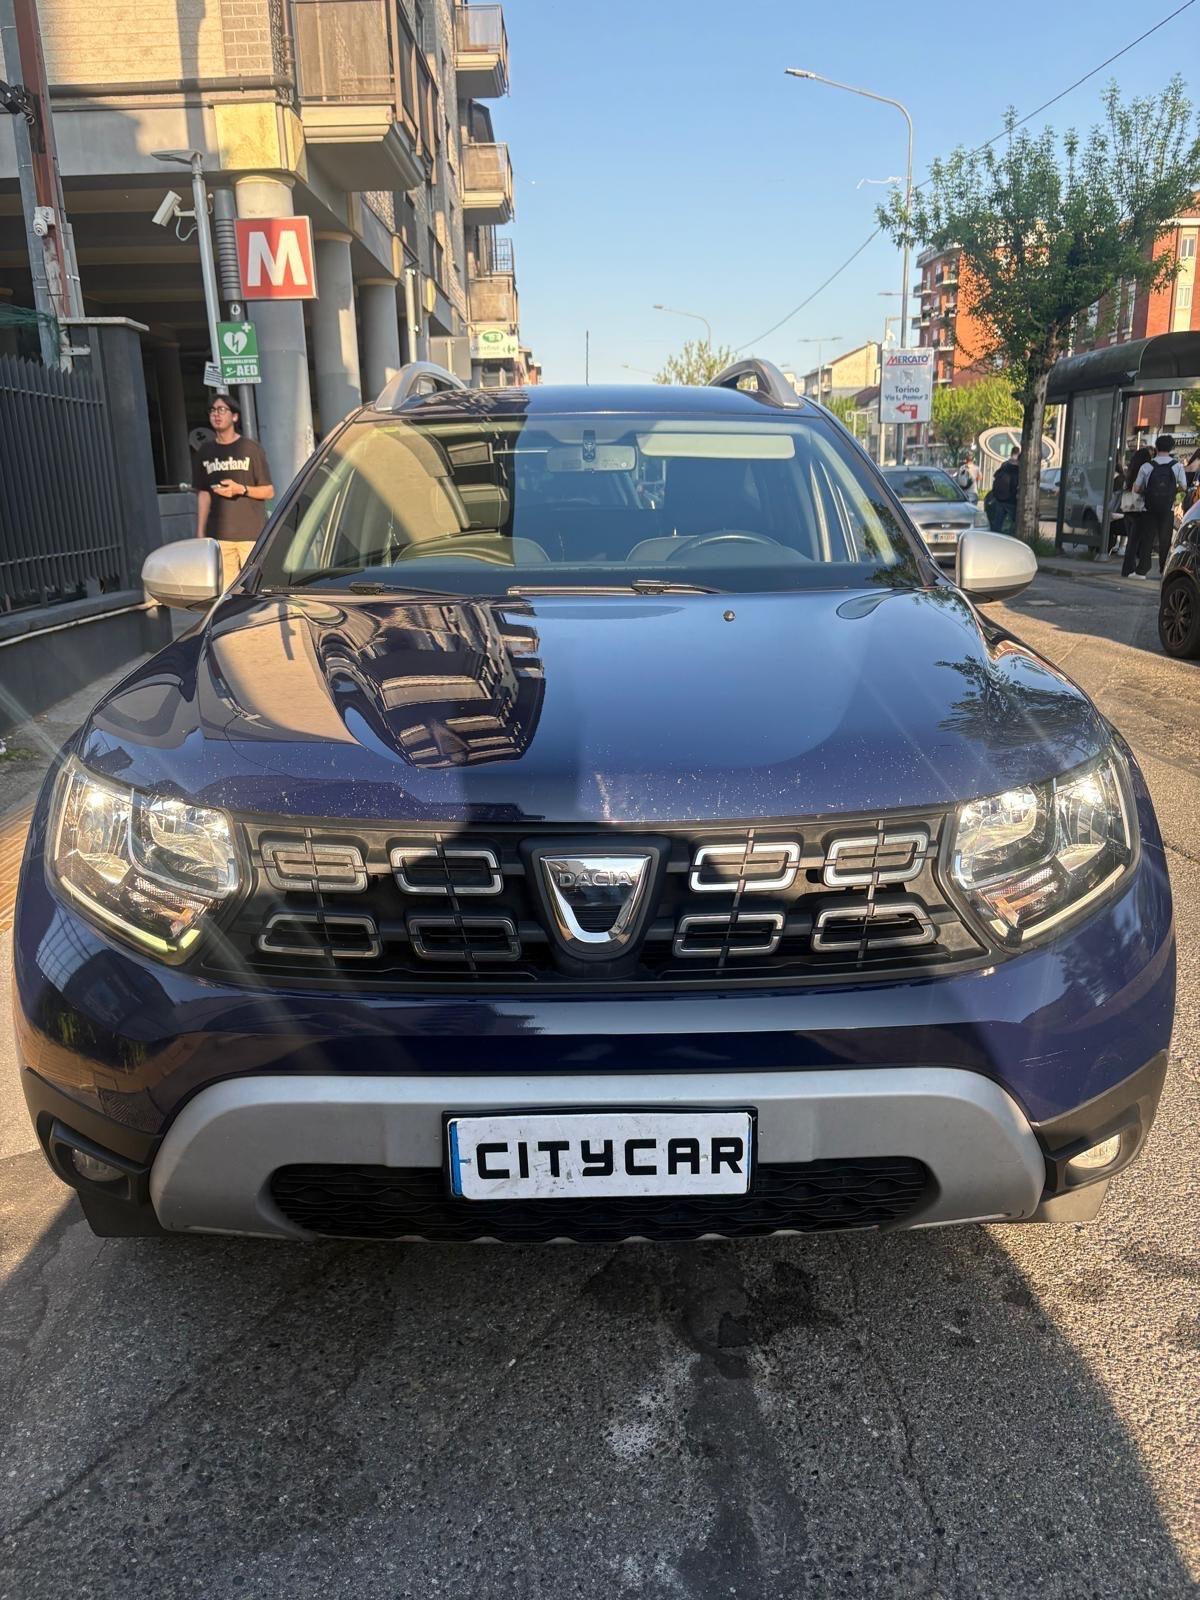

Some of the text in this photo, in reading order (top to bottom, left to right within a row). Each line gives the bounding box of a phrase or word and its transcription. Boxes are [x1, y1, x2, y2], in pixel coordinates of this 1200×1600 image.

[247, 230, 308, 287] M
[887, 355, 929, 366] MERCATO
[236, 364, 258, 376] AED
[895, 385, 920, 393] Torino
[203, 456, 250, 475] Timberland
[559, 871, 633, 887] DACIA
[476, 1136, 744, 1180] CITYCAR
